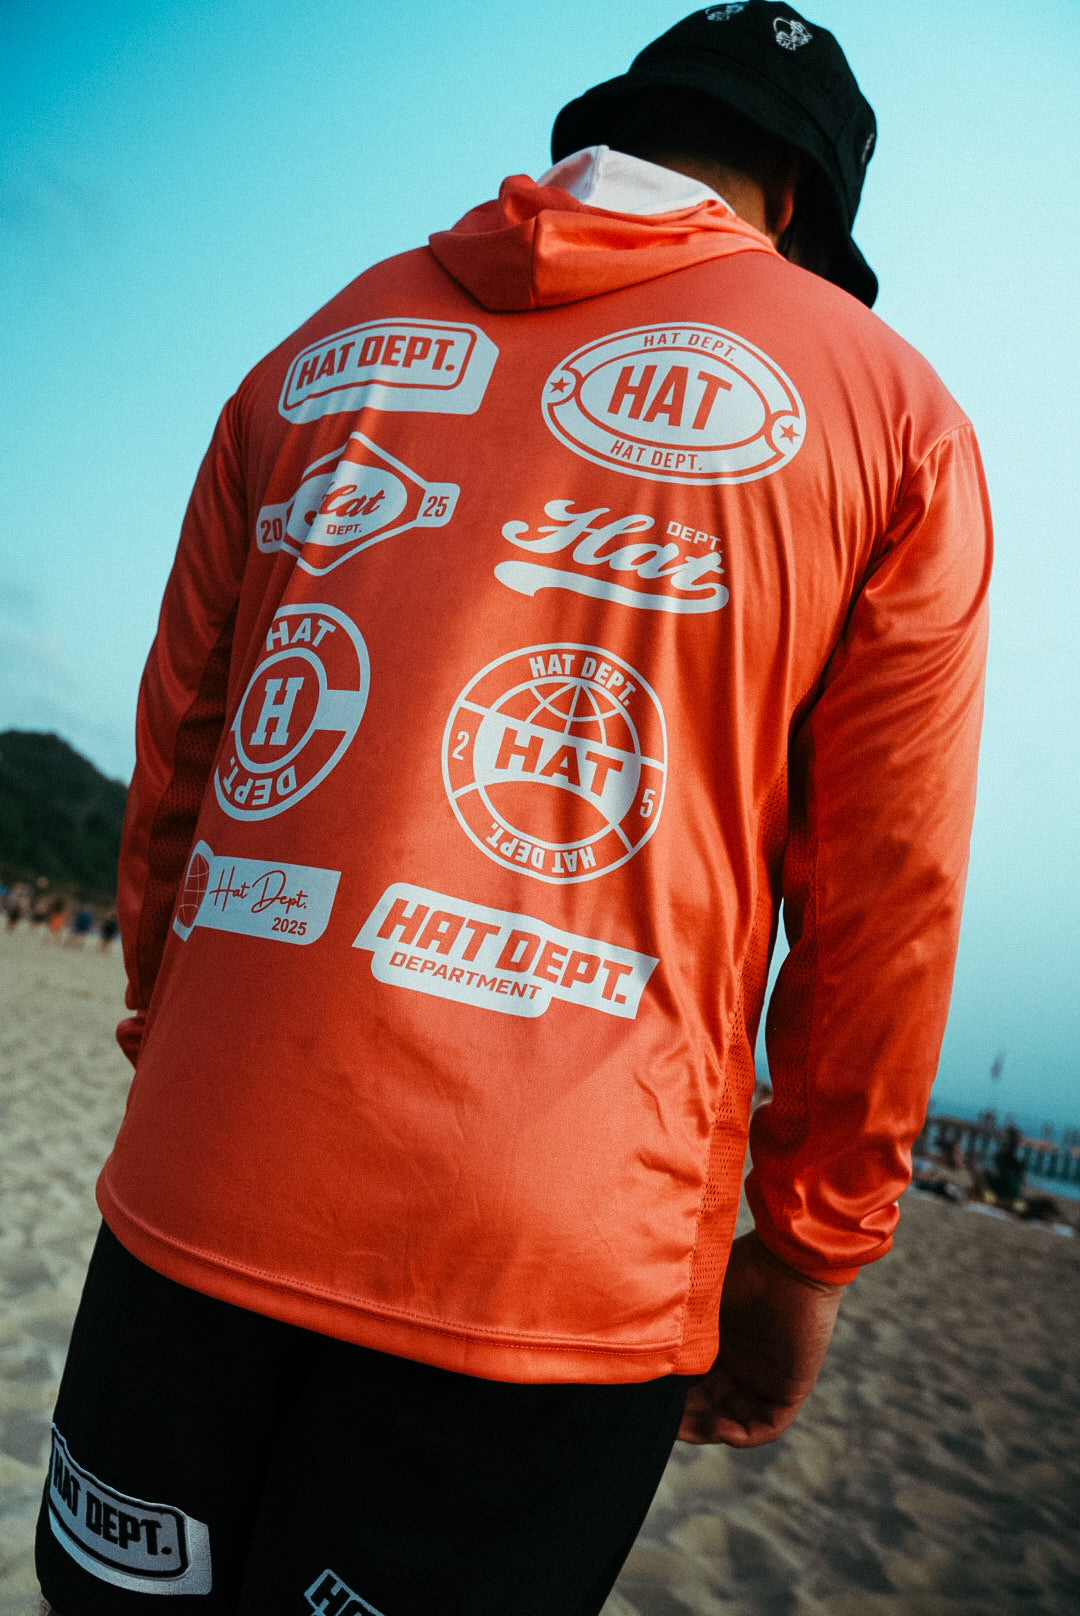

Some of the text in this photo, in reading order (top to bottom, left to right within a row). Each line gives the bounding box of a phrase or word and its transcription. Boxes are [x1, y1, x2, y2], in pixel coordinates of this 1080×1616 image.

[295, 334, 455, 391] HAT DEPT.
[643, 332, 738, 362] HAT DEPT.
[606, 364, 733, 431] HAT
[610, 439, 703, 472] HAT DEPT.
[260, 517, 283, 544] 20
[326, 523, 362, 536] DEPT.
[422, 495, 450, 518] 25
[499, 499, 730, 597] Hat
[266, 617, 337, 652] HAT
[528, 653, 637, 706] HAT DEPT.
[249, 676, 305, 746] H
[452, 730, 470, 761] 2
[494, 725, 624, 799] HAT
[223, 757, 297, 806] DEPT.
[639, 787, 657, 818] 5
[485, 821, 597, 874] HAT DEPT.
[209, 865, 309, 915] Hat Dept.
[271, 916, 308, 936] 2025
[376, 897, 634, 1005] HAT DEPT.
[388, 951, 543, 1001] DEPARTMENT
[86, 1490, 173, 1556] DEPT.
